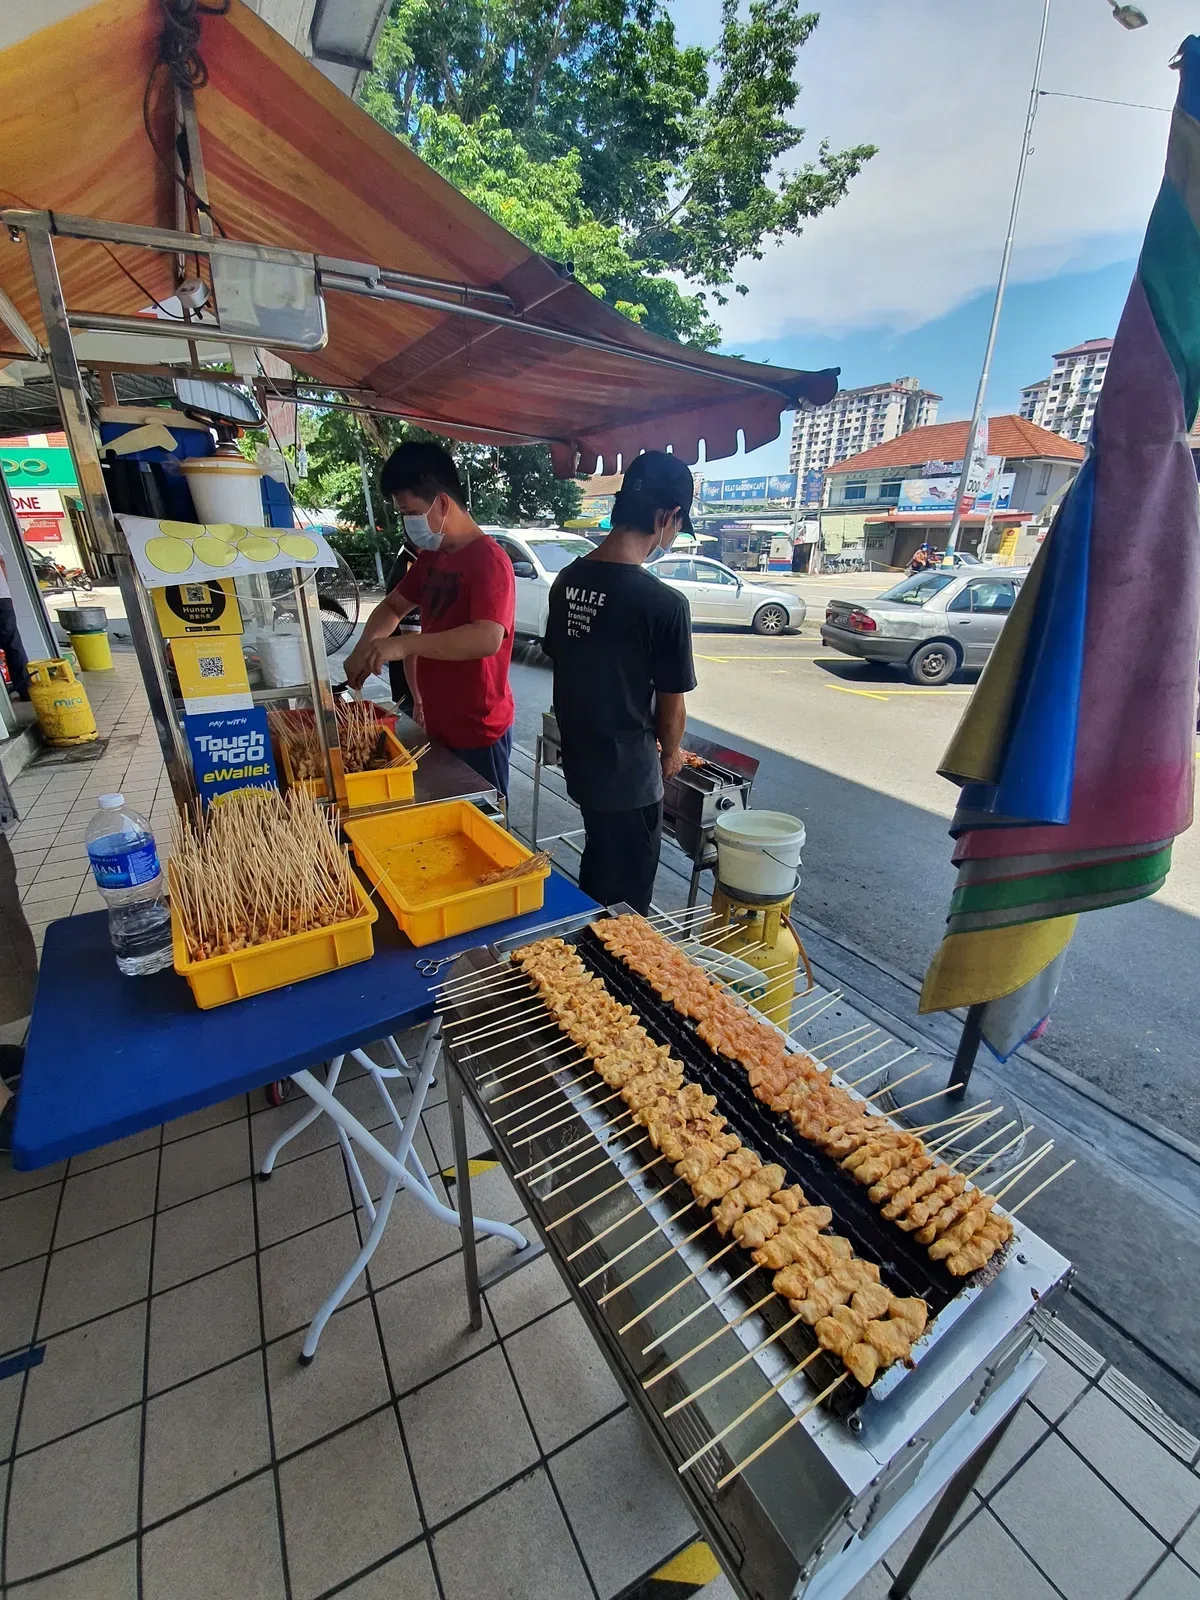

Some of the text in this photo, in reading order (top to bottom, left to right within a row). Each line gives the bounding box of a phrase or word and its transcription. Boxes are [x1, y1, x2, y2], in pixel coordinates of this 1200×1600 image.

[736, 483, 752, 491] GARDEN
[565, 586, 606, 607] W.I.F.E
[183, 605, 214, 614] Hungry
[569, 602, 597, 617] Washing
[568, 611, 591, 624] Ironing
[209, 717, 247, 728] PAY WITH
[194, 730, 265, 752] Touch
[203, 763, 270, 783] eWallet
